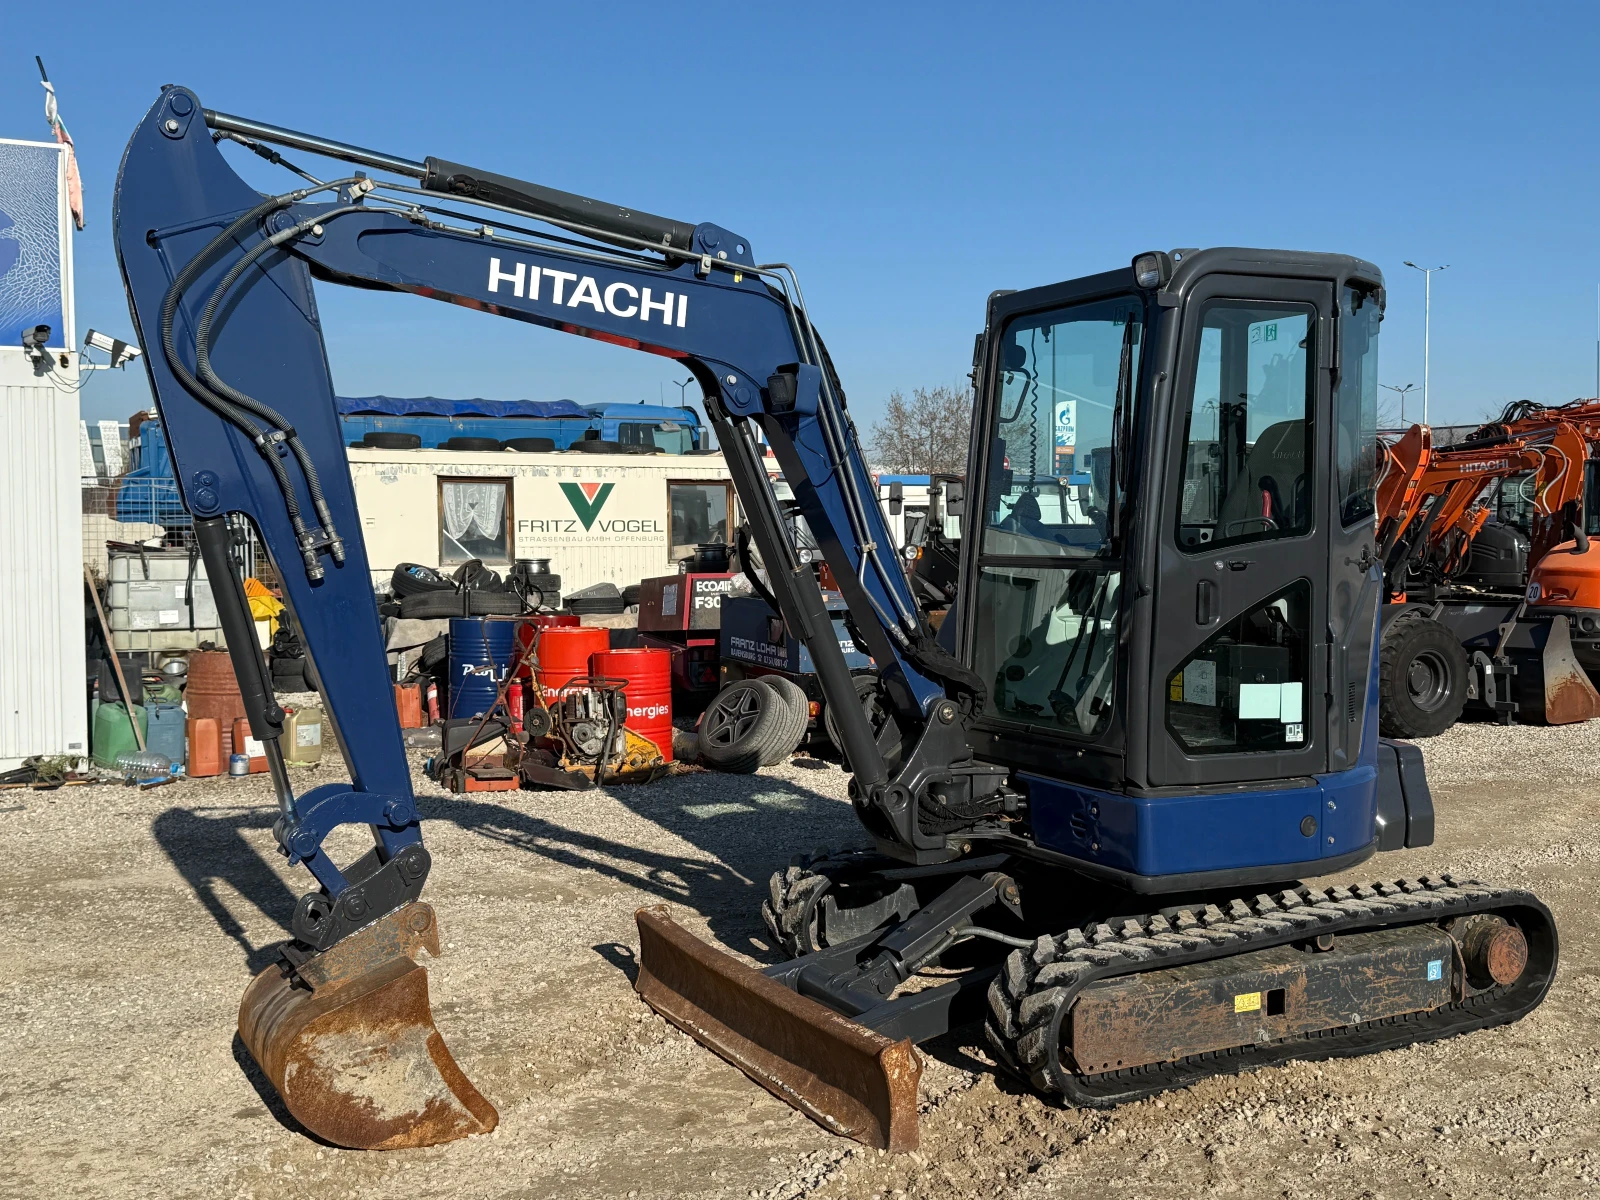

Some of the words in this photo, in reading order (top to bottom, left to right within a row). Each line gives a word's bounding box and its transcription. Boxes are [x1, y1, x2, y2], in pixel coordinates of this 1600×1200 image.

[487, 257, 689, 328] HITACHI
[1460, 459, 1509, 473] HITACHI
[518, 519, 577, 533] FRITZ
[598, 519, 664, 533] VOGEL
[1528, 586, 1538, 599] 20
[731, 636, 755, 650] FRANZ
[756, 641, 776, 656] LOHR
[626, 703, 669, 720] nergies
